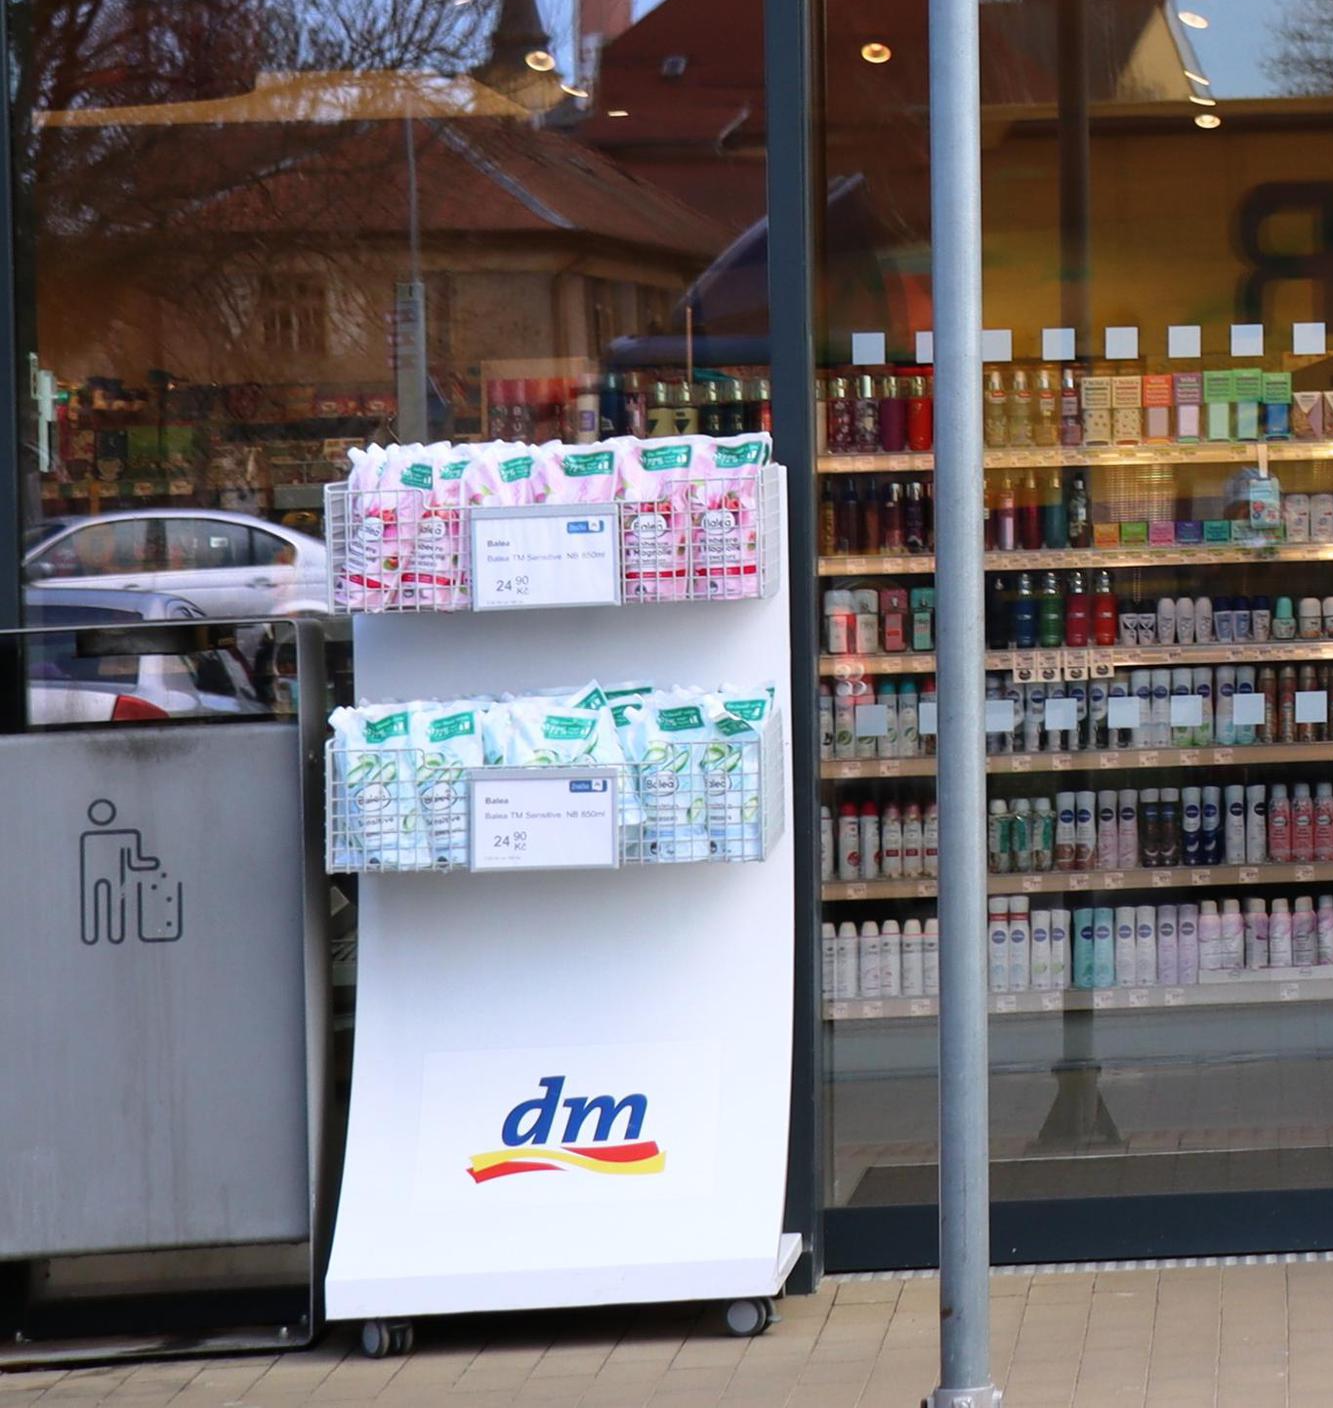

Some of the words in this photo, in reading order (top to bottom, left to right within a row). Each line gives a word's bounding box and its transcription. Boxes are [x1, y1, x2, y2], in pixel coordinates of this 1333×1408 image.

[496, 580, 512, 592] 24
[515, 575, 529, 585] 90
[494, 835, 510, 847] 24
[513, 831, 527, 841] 90
[501, 1075, 648, 1147] dm
